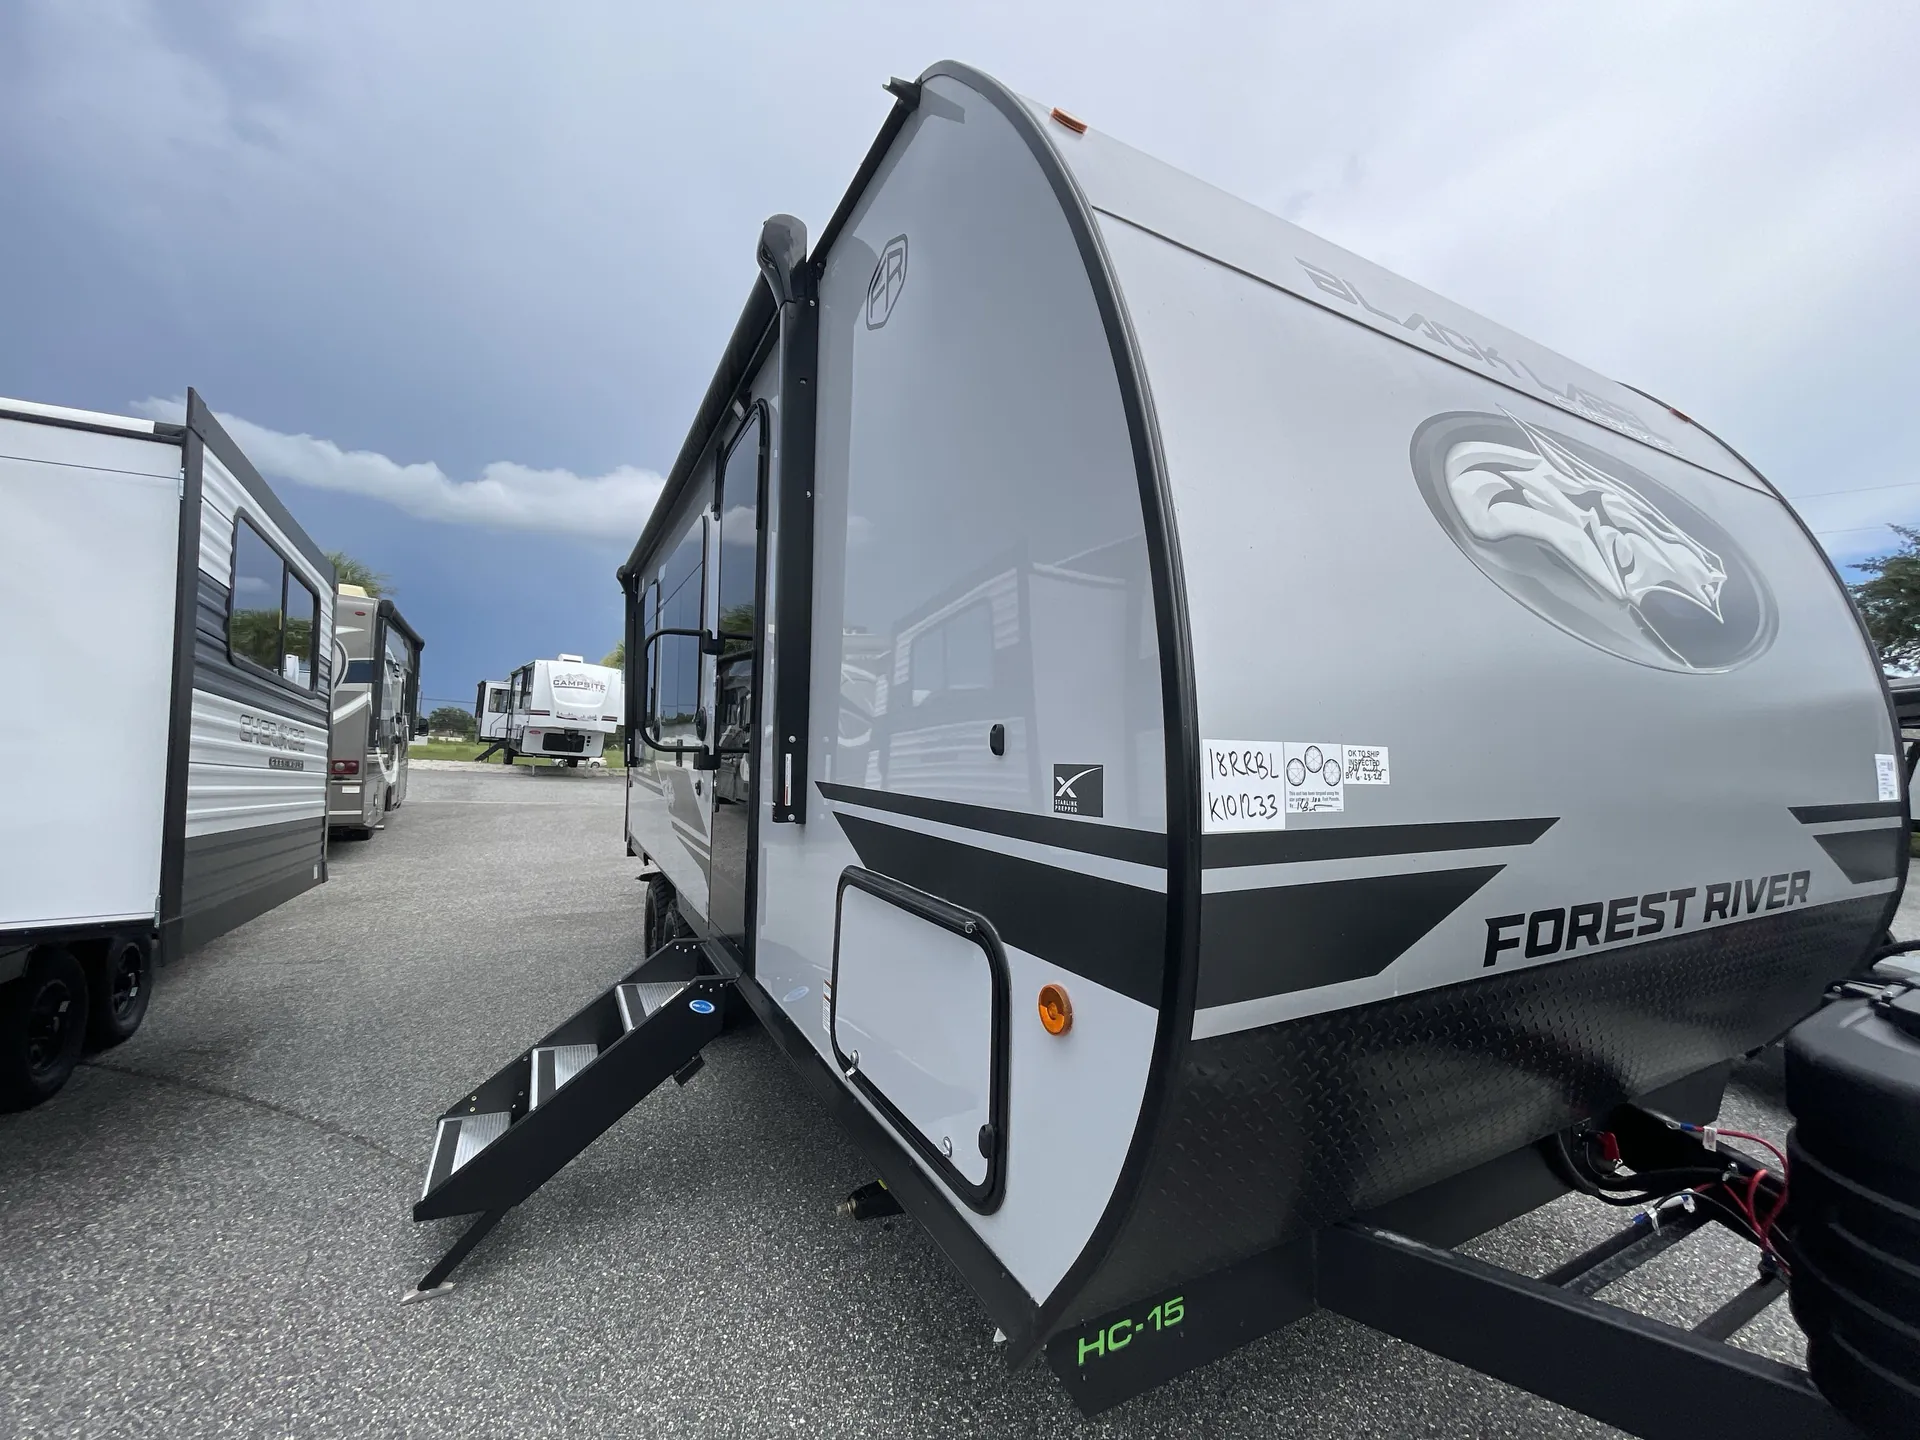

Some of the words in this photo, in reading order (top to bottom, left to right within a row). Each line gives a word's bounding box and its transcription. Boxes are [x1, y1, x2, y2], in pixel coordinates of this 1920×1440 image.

[1296, 257, 1520, 379] BLACK
[553, 679, 606, 691] CAMPSITE
[1347, 749, 1357, 758] OK
[1357, 750, 1366, 758] TO
[1367, 750, 1380, 758] SHIP
[1209, 748, 1279, 780] 18RRBL
[1348, 758, 1381, 767] INSPECTED
[1055, 799, 1078, 807] STARLINK
[1055, 805, 1078, 813] PREPPED
[1483, 887, 1697, 968] FOREST
[1702, 870, 1812, 923] RIVER
[1078, 1296, 1185, 1366] HC-15
